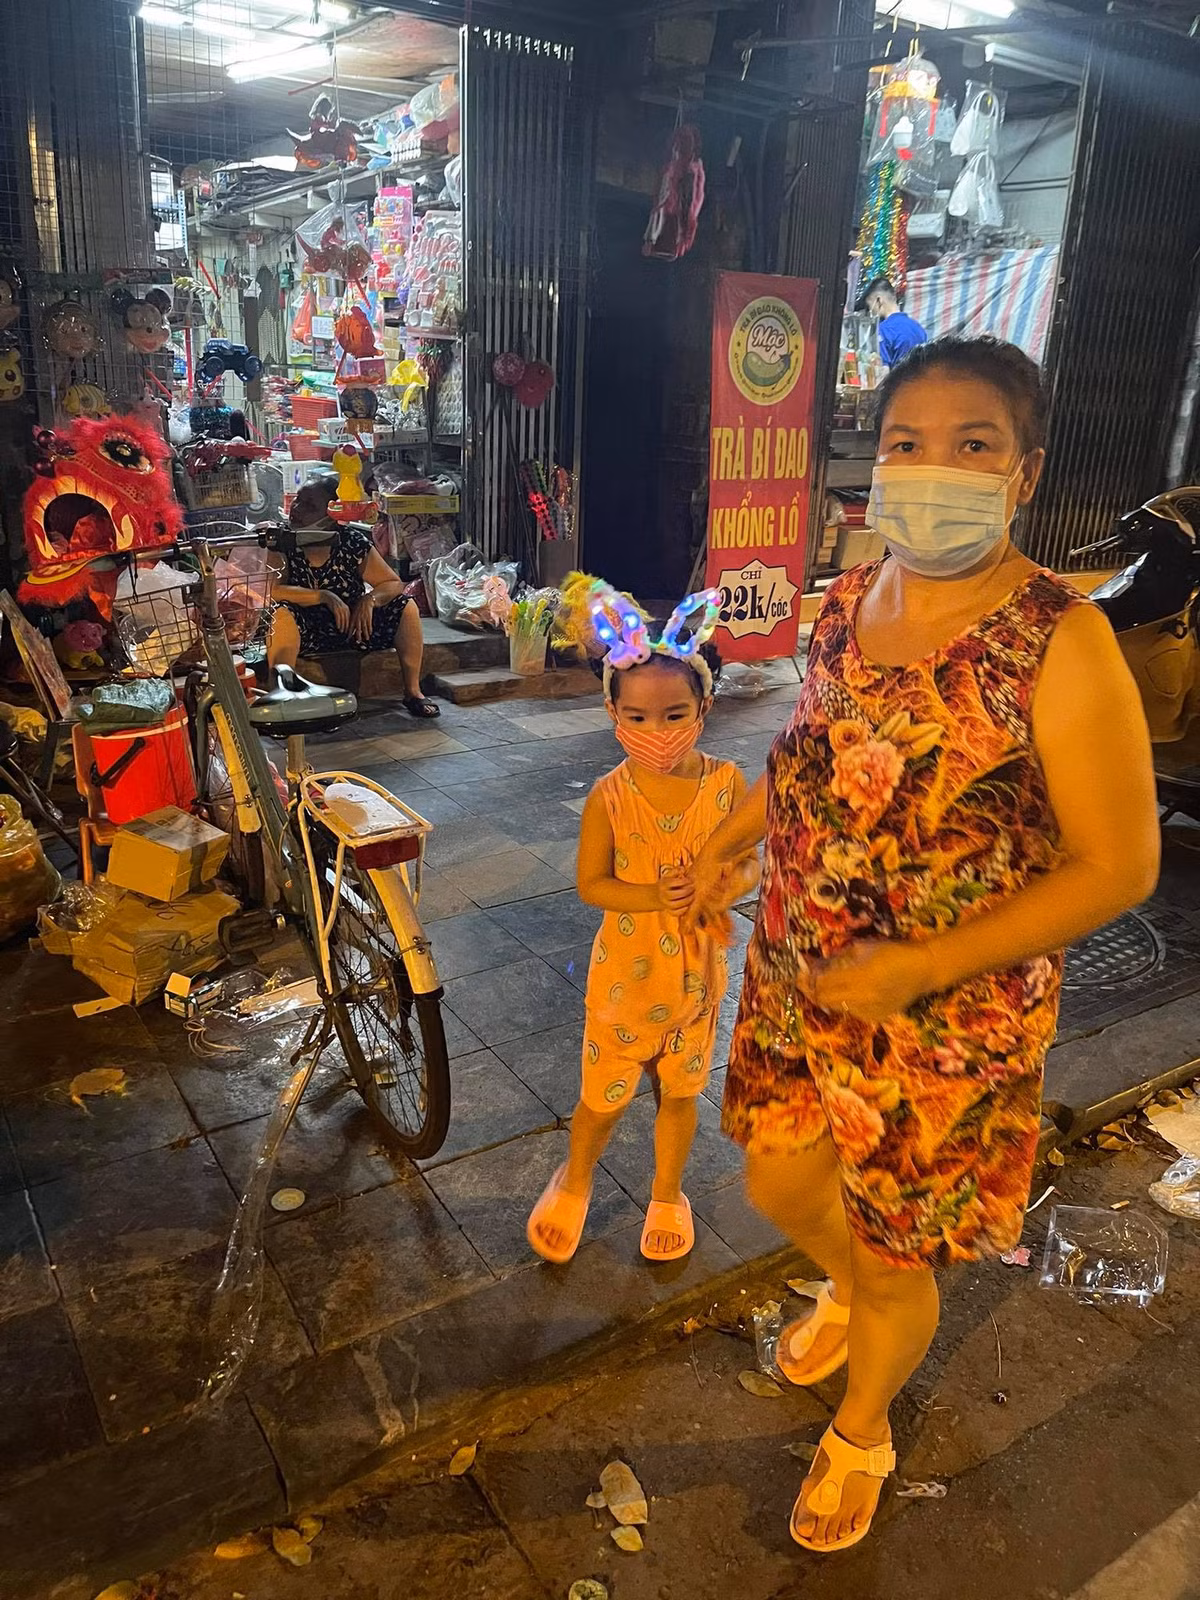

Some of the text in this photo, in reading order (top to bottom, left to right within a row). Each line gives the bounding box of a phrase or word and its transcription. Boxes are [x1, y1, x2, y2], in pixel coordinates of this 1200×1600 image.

[752, 324, 785, 352] Mộc
[712, 415, 809, 481] TRÀ BÍ ĐAO
[711, 490, 776, 550] KHỔNG
